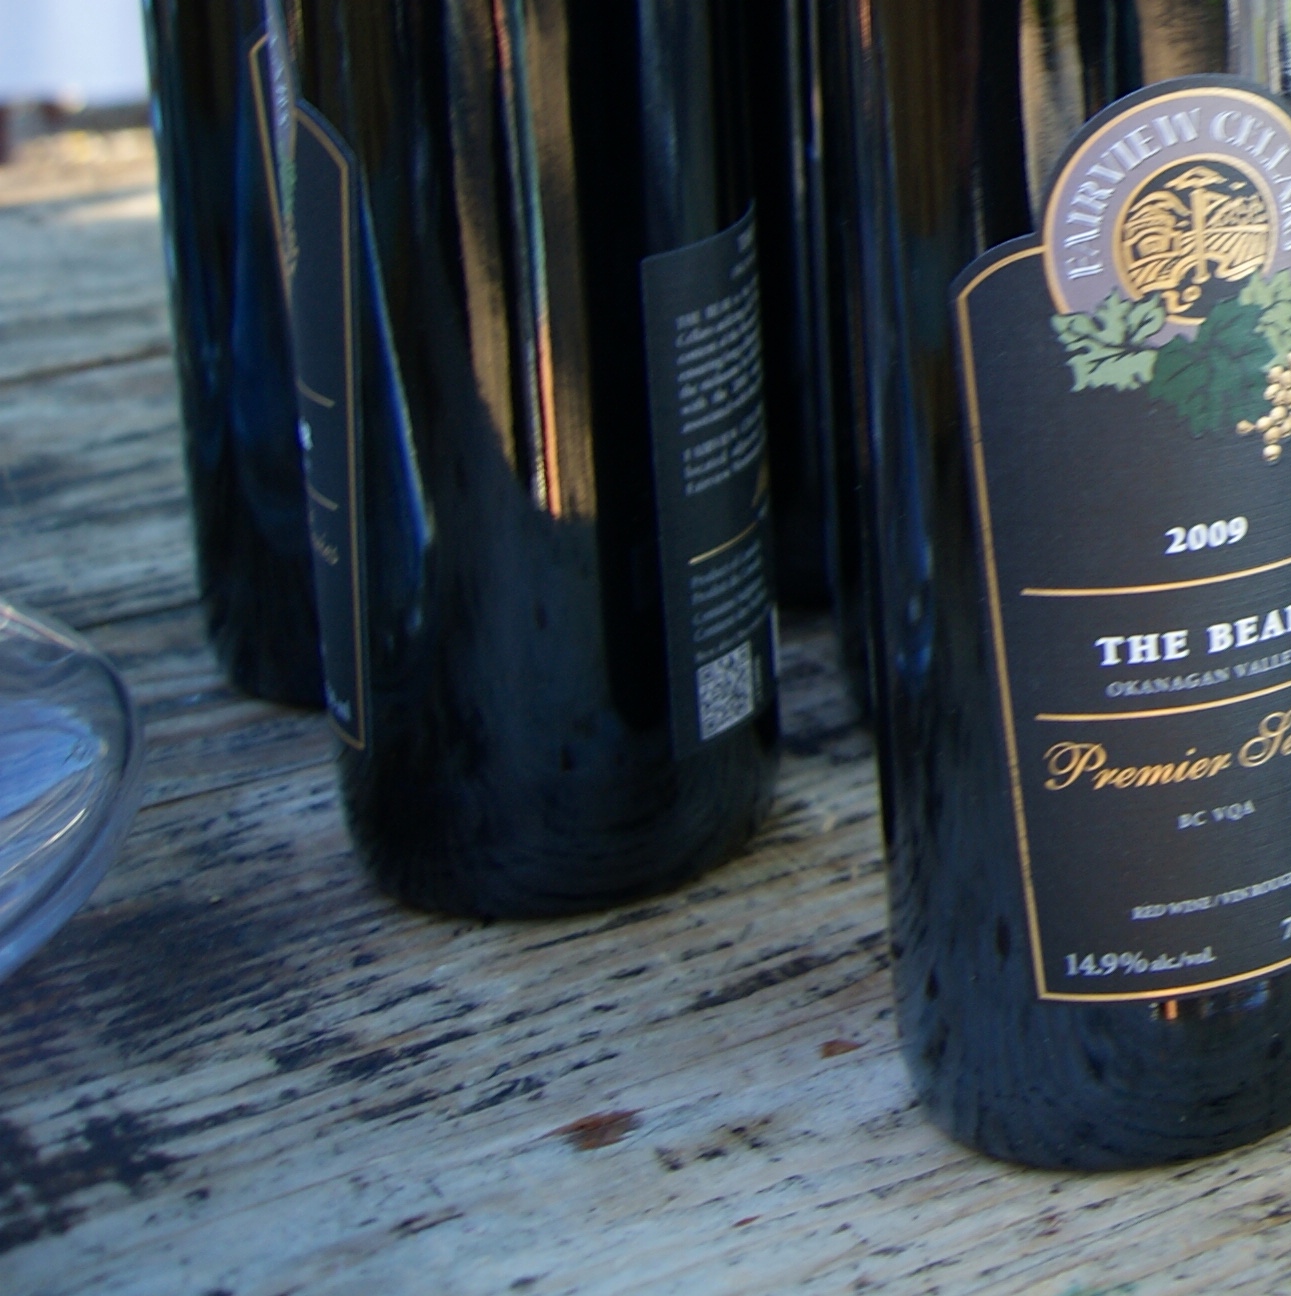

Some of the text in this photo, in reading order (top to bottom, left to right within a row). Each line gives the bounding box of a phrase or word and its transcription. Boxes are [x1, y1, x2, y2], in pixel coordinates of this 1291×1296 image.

[1065, 108, 1202, 280] FAIRVIEW
[1164, 515, 1250, 554] 2009
[1094, 630, 1191, 667] THE
[1105, 667, 1232, 699] OKANAGAN
[1042, 740, 1234, 792] Premier
[1177, 799, 1257, 830] BC VQA
